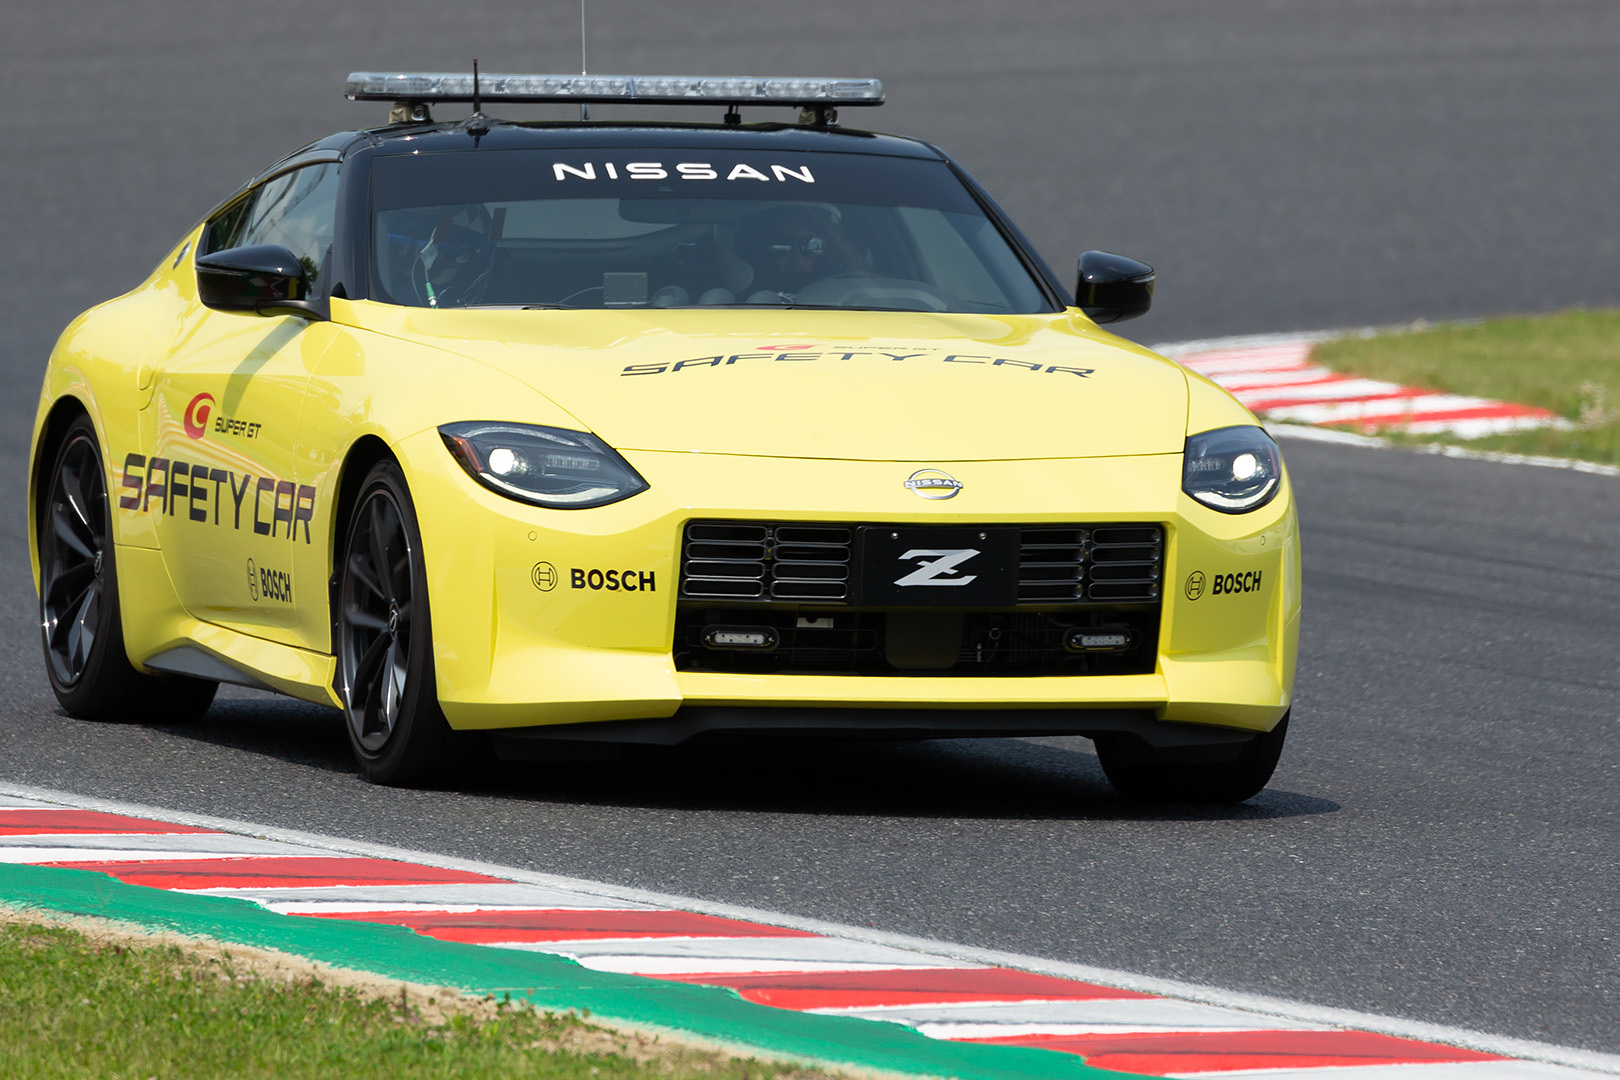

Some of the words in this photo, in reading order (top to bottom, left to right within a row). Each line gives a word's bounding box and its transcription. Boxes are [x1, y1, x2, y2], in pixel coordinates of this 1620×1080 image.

[552, 162, 815, 183] NISSAN
[620, 352, 931, 377] SAFETY
[943, 354, 1096, 379] CAR
[214, 416, 247, 437] SUPER
[246, 422, 262, 439] GT
[904, 479, 963, 489] NISSAN
[119, 453, 252, 530] SAFETY
[253, 476, 317, 545] CAR
[570, 568, 656, 592] BOSCH
[893, 548, 982, 587] Z
[260, 567, 293, 603] BOSCH
[1211, 570, 1263, 595] BOSCH
